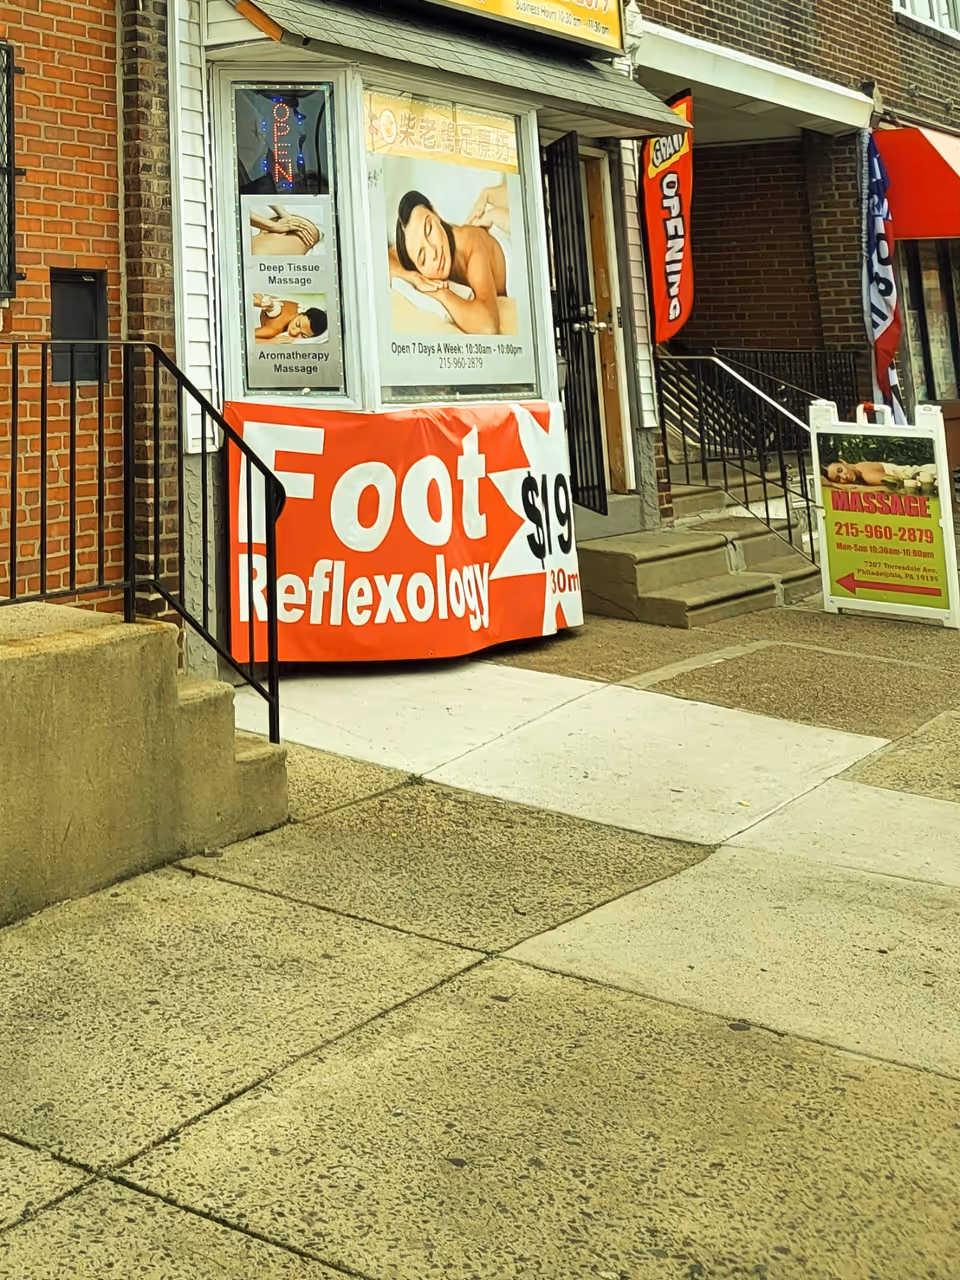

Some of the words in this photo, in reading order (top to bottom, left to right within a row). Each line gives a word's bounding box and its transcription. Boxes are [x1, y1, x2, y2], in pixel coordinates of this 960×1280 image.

[541, 5, 557, 20] Hours
[273, 102, 293, 183] OPEN
[661, 172, 685, 322] OPENING
[259, 263, 284, 273] Deep
[287, 263, 320, 272] Tissue
[268, 276, 312, 286] Massage
[258, 351, 330, 361] Aromatherapy
[391, 342, 411, 356] Open
[412, 342, 416, 353] 7
[418, 342, 435, 356] Days
[437, 343, 442, 354] A
[443, 343, 464, 354] Week:
[465, 343, 492, 355] 10:30am
[497, 344, 523, 356] 10:00pm
[273, 364, 318, 375] Massage
[439, 357, 483, 369] 215-960-2879
[238, 420, 487, 552] Foot
[831, 490, 932, 518] MASSAGE
[521, 471, 572, 570] $19
[834, 521, 935, 544] 215-960-2879
[836, 542, 868, 553] Mon-Sun
[883, 562, 921, 572] Torresdale
[922, 566, 938, 574] Ave.
[238, 552, 490, 632] Reflexology
